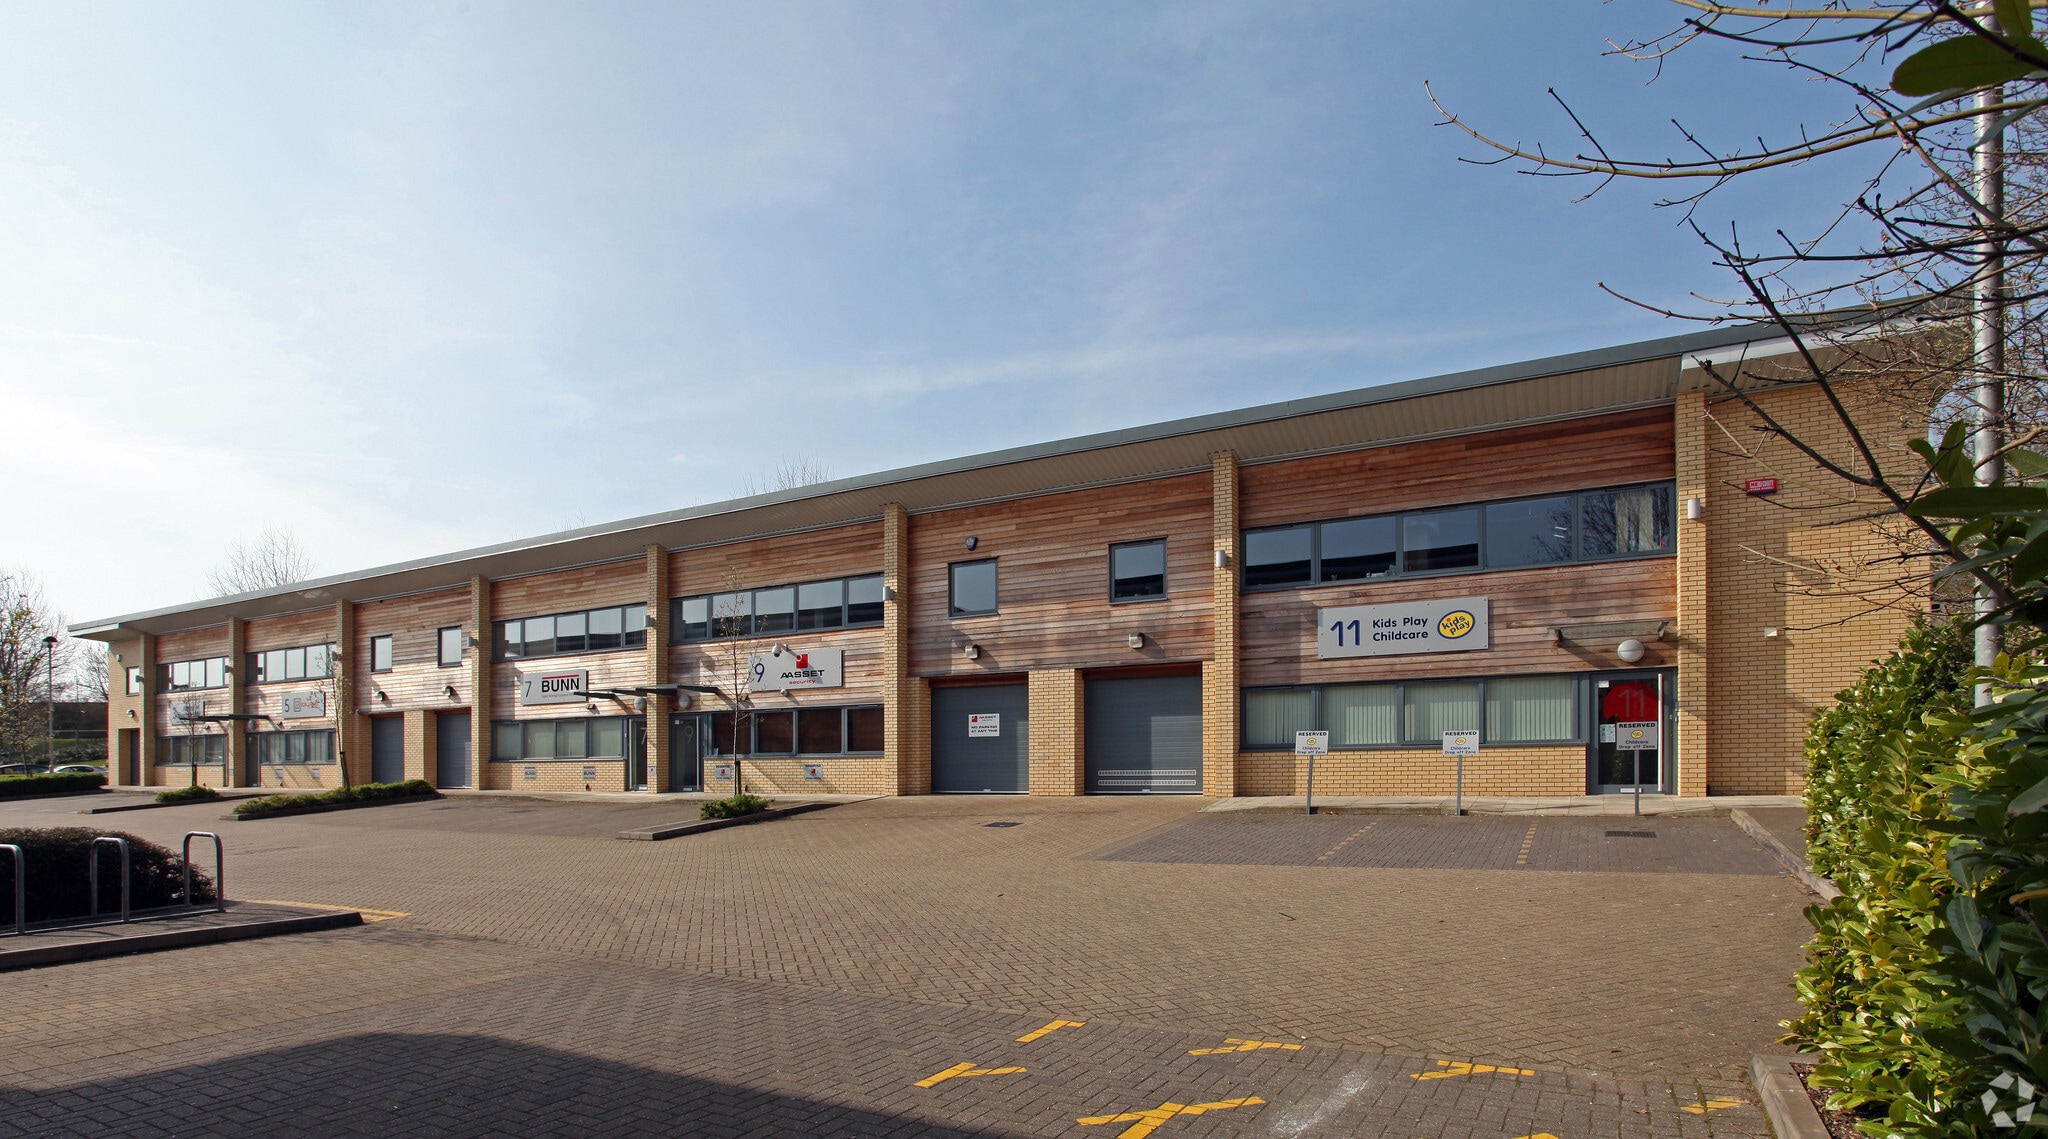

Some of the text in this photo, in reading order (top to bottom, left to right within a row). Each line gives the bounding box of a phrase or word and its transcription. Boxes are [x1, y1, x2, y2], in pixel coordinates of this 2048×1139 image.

[1372, 616, 1428, 628] Kids Play
[1441, 615, 1466, 630] kids
[1449, 620, 1471, 636] play
[1330, 619, 1360, 647] 11
[1373, 630, 1429, 642] Childcare
[754, 662, 765, 683] 9
[780, 669, 825, 679] AASSET
[525, 680, 532, 698] 7
[541, 677, 580, 693] BUNN
[284, 698, 290, 713] 5
[1619, 689, 1645, 718] 11
